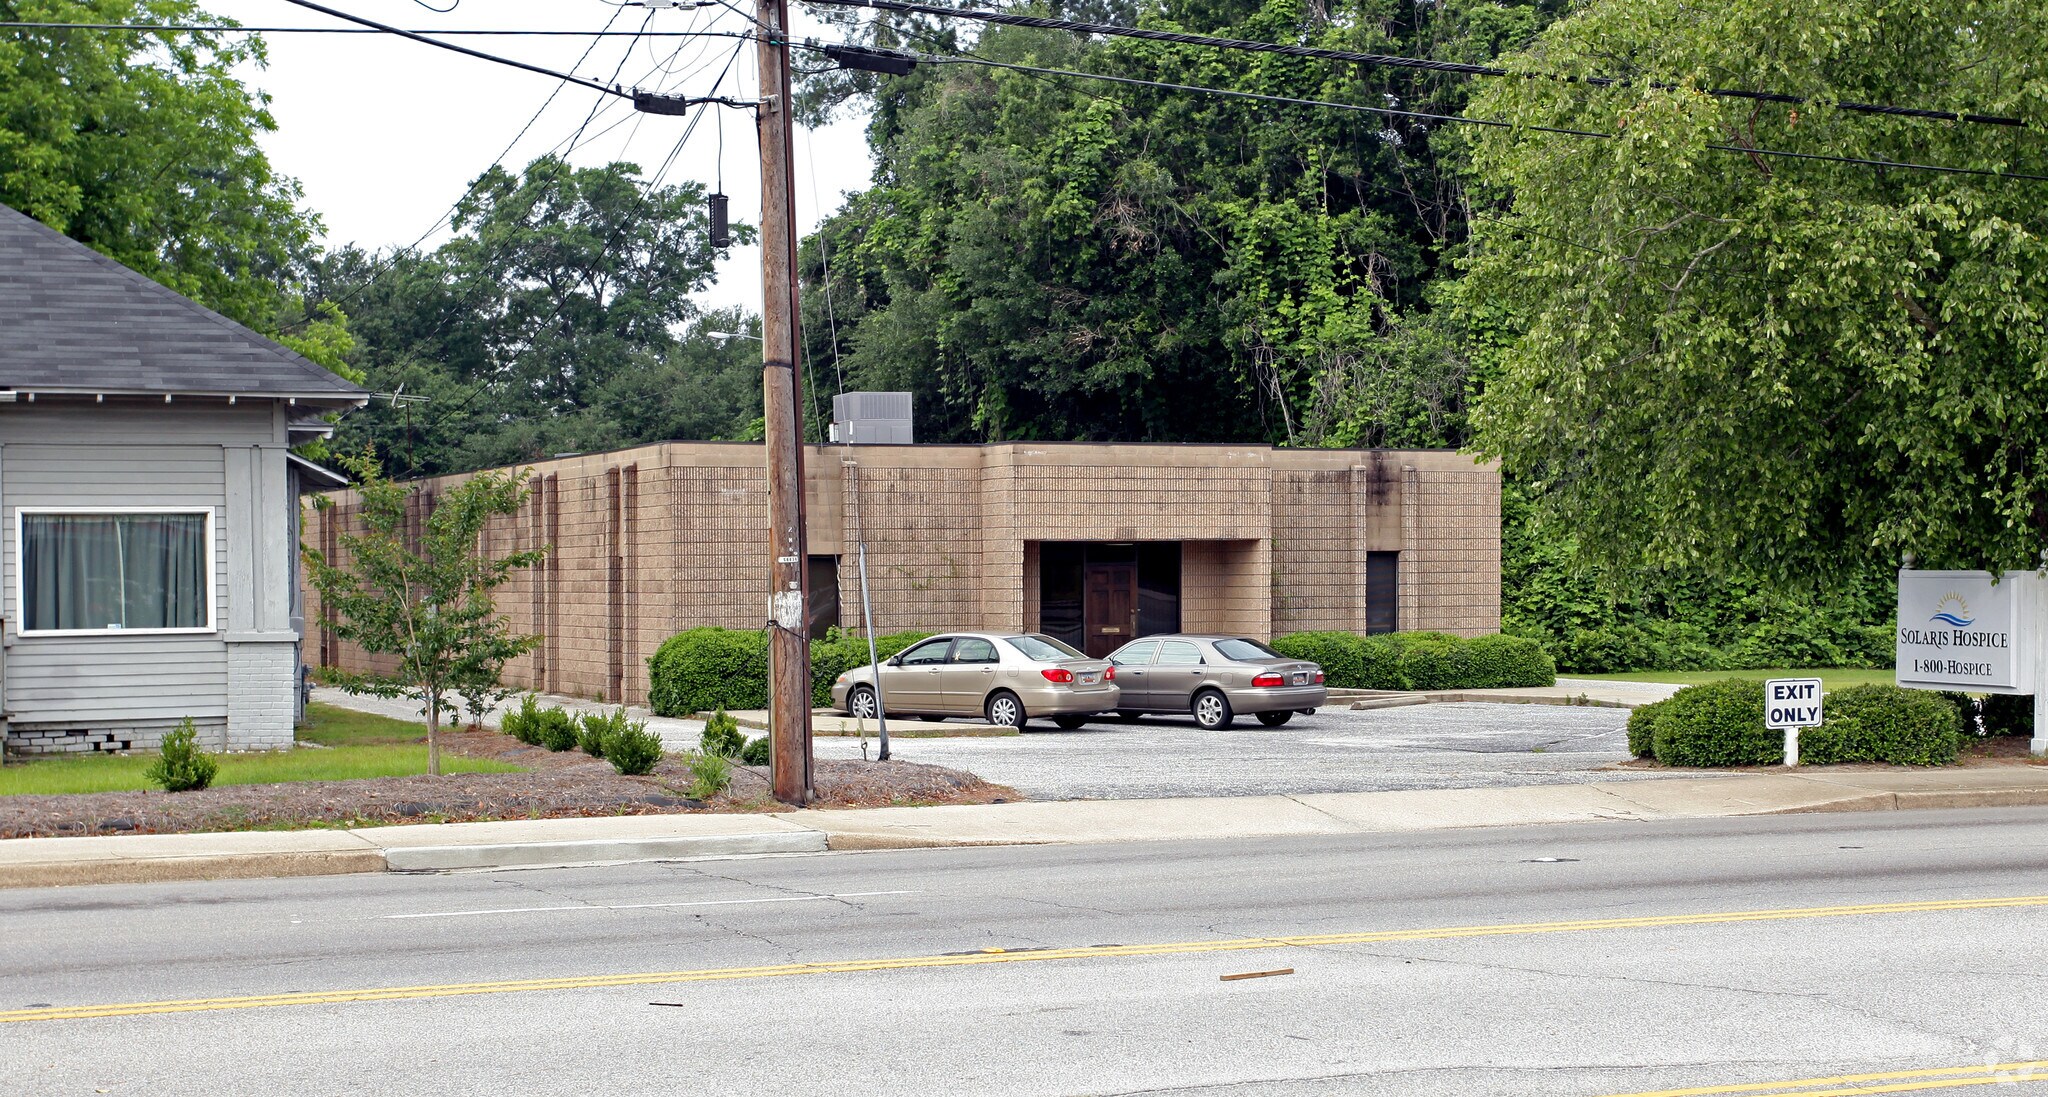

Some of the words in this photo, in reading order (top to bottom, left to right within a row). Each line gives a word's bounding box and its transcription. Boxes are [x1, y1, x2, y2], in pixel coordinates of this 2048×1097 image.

[1900, 627, 1949, 650] SOLARIS
[1952, 629, 2008, 648] HOSPICE
[1913, 658, 1993, 676] 1-800-HOSPICE
[1774, 684, 1815, 700] EXIT
[1770, 706, 1819, 723] ONLY
